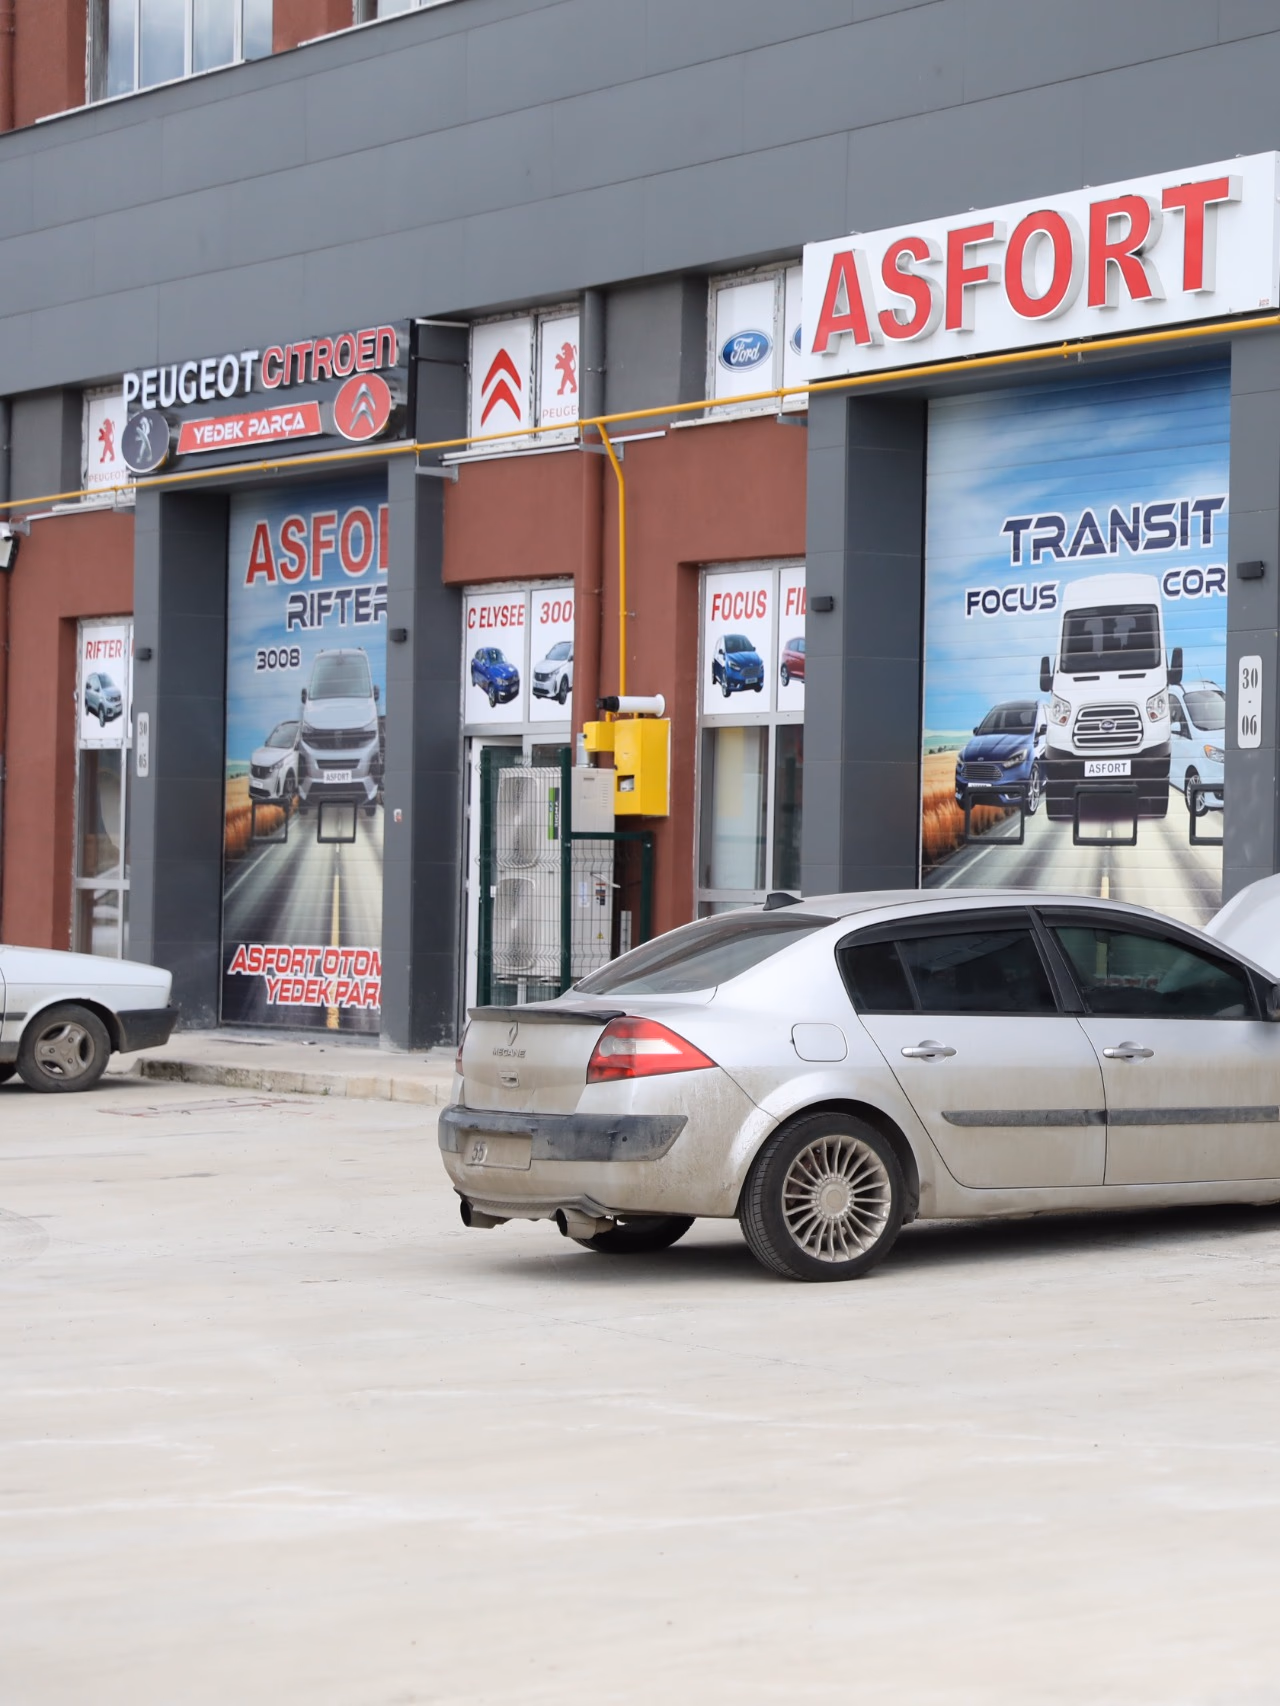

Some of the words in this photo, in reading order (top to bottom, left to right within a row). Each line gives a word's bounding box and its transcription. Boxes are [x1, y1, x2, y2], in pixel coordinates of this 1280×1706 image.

[811, 174, 1243, 355] ASFORT
[730, 337, 760, 365] Ford
[123, 349, 259, 410] PEUGEOT
[262, 324, 398, 388] CITROEN
[542, 405, 579, 418] PEUGE
[193, 422, 244, 444] YEDEK
[248, 411, 306, 438] PARÇA
[1001, 495, 1227, 564] TRANSIT
[245, 505, 388, 586] ASFO
[540, 600, 574, 624] 300
[711, 590, 767, 621] FOCUS
[966, 582, 1059, 617] FOCUS
[468, 607, 477, 629] C
[479, 604, 525, 628] ELYSEE
[85, 639, 122, 660] RIFTER
[256, 647, 301, 671] 3008
[1242, 668, 1258, 689] 30
[139, 721, 148, 736] 30
[1241, 714, 1258, 736] 06
[325, 771, 350, 782] ASFORT
[1088, 762, 1128, 774] ASFORT
[229, 946, 322, 975] ASFORT
[266, 977, 334, 1005] YEDEK
[334, 980, 382, 1008] PAR
